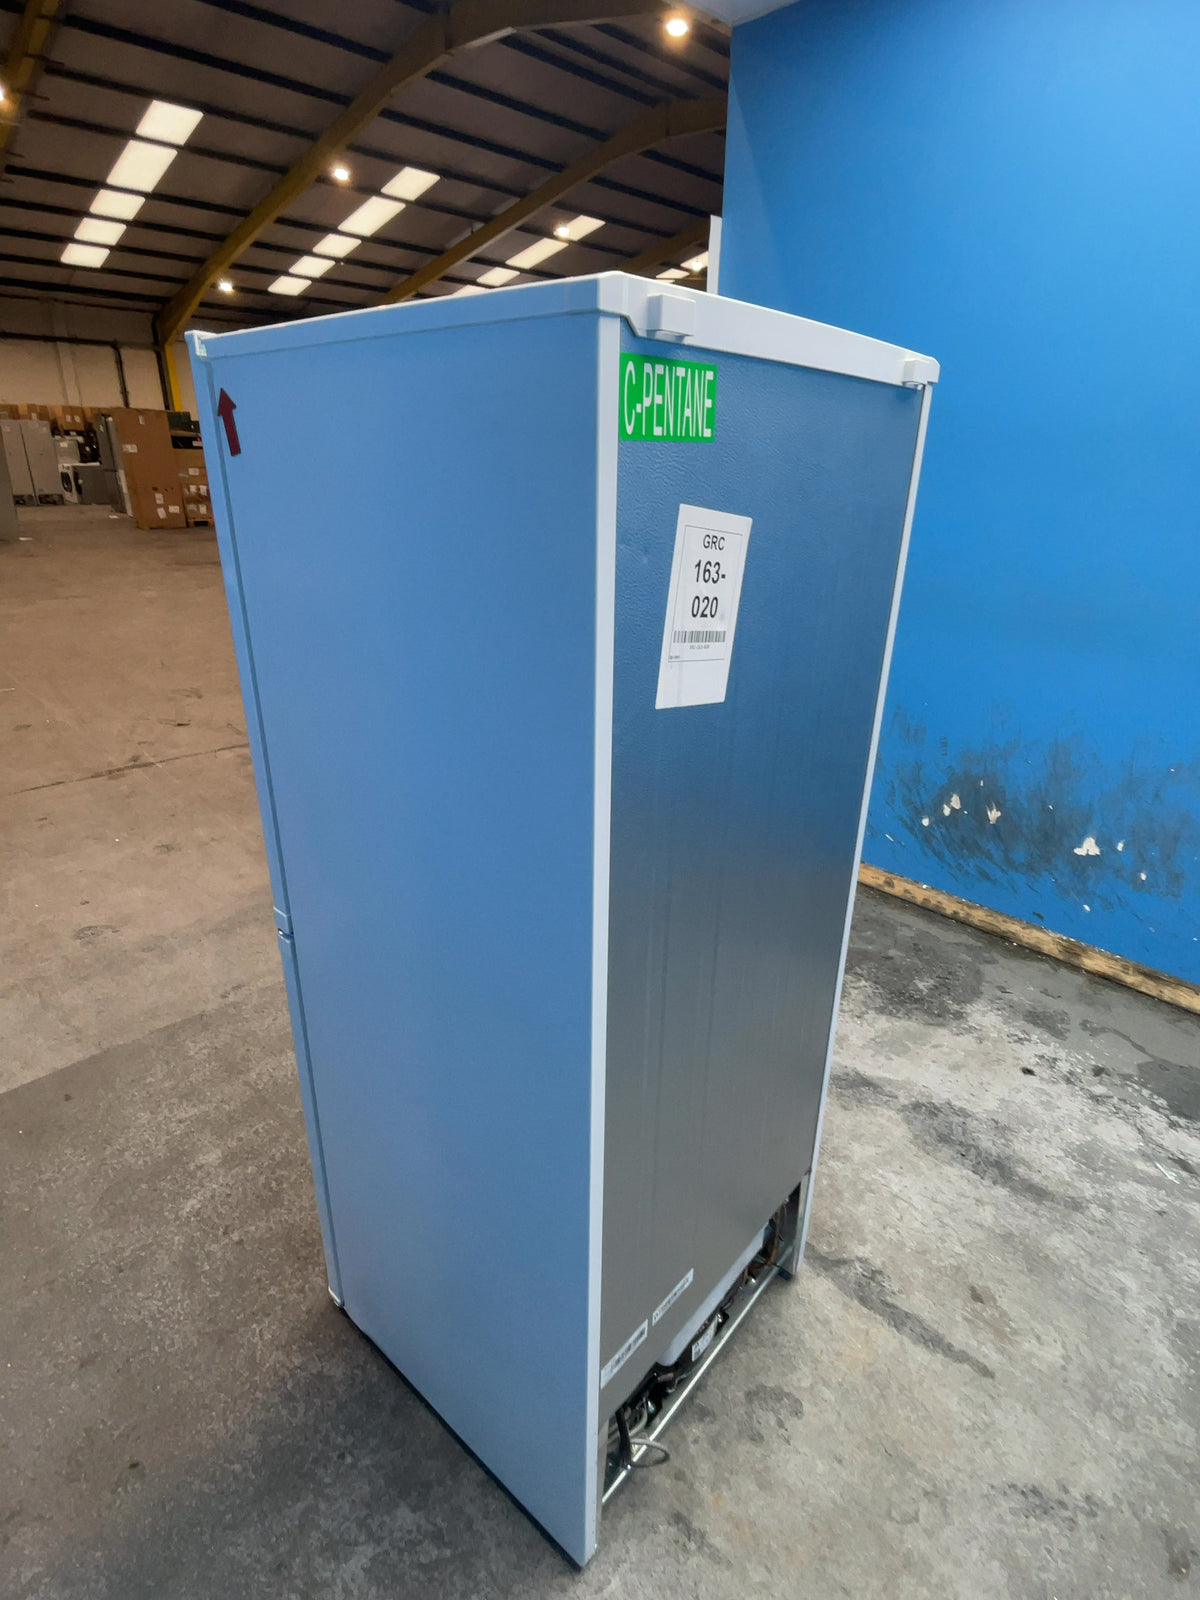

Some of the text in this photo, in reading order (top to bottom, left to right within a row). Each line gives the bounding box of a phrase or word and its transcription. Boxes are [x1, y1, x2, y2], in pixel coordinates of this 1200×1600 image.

[624, 360, 714, 438] C-PENTANE
[703, 534, 726, 550] GRC
[695, 559, 726, 584] 163-
[691, 595, 719, 618] 020
